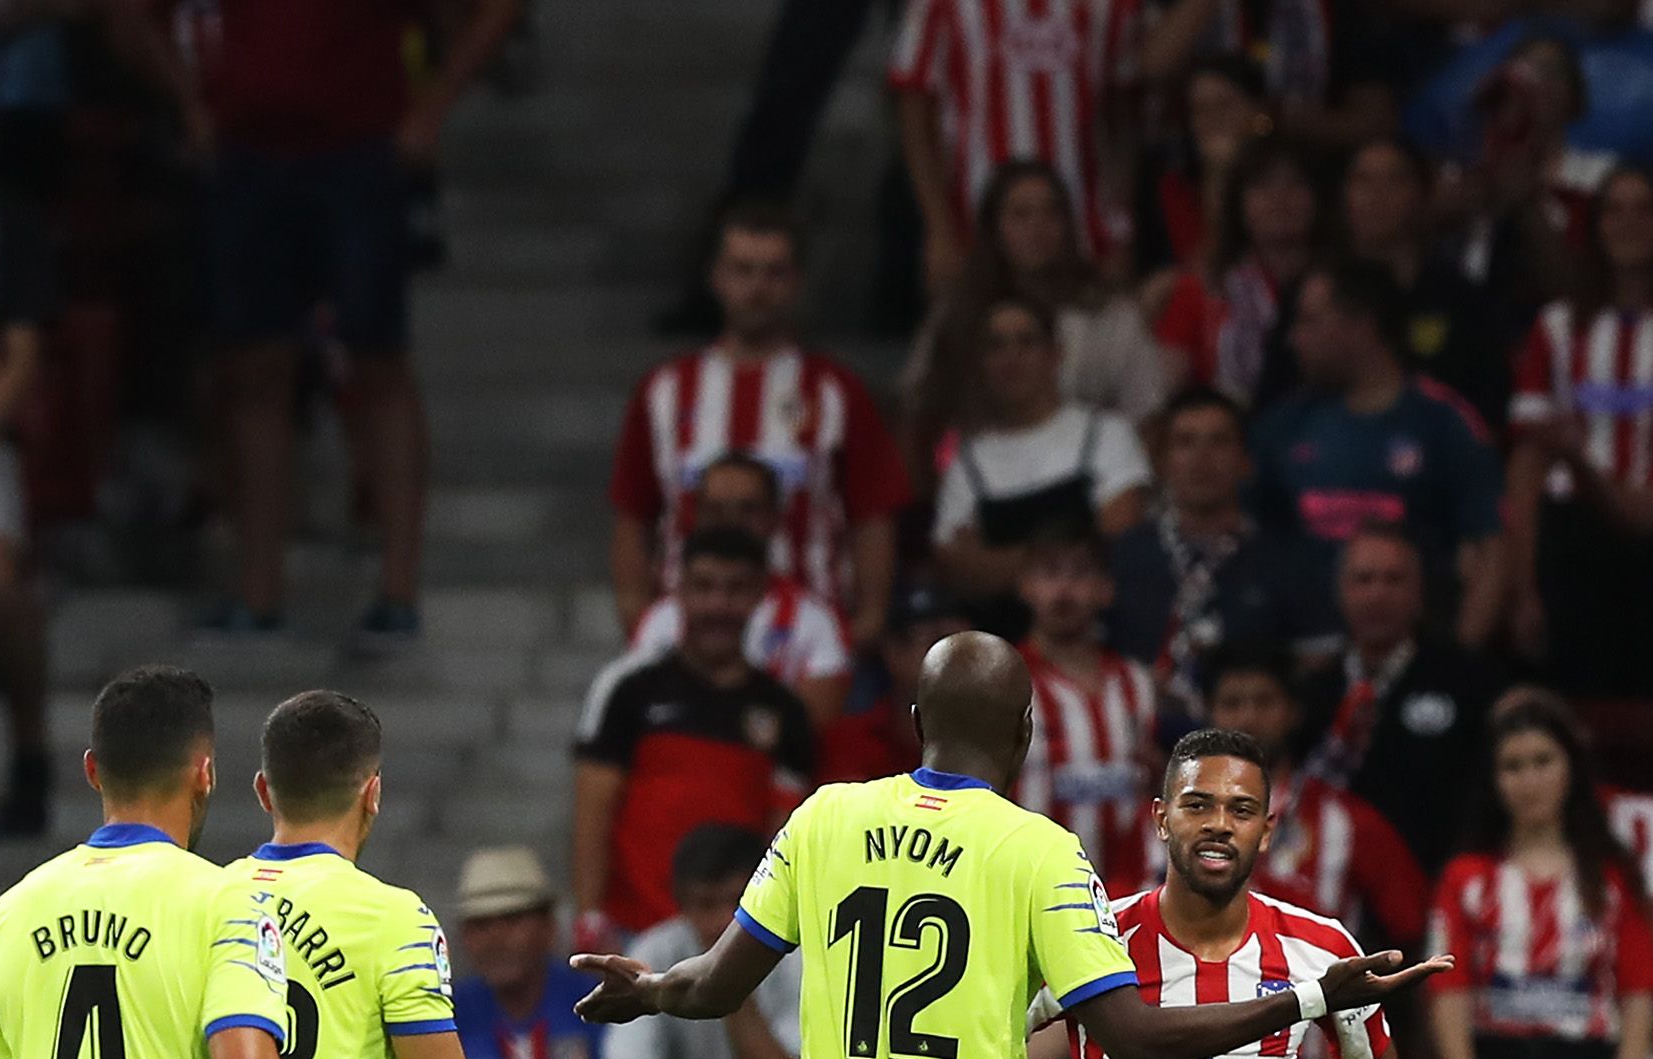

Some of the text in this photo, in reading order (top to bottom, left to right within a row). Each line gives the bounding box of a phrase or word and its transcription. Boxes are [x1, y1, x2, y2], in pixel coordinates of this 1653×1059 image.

[865, 825, 963, 878] NYOM
[32, 910, 152, 963] BRUNO
[277, 898, 356, 992] BARRI
